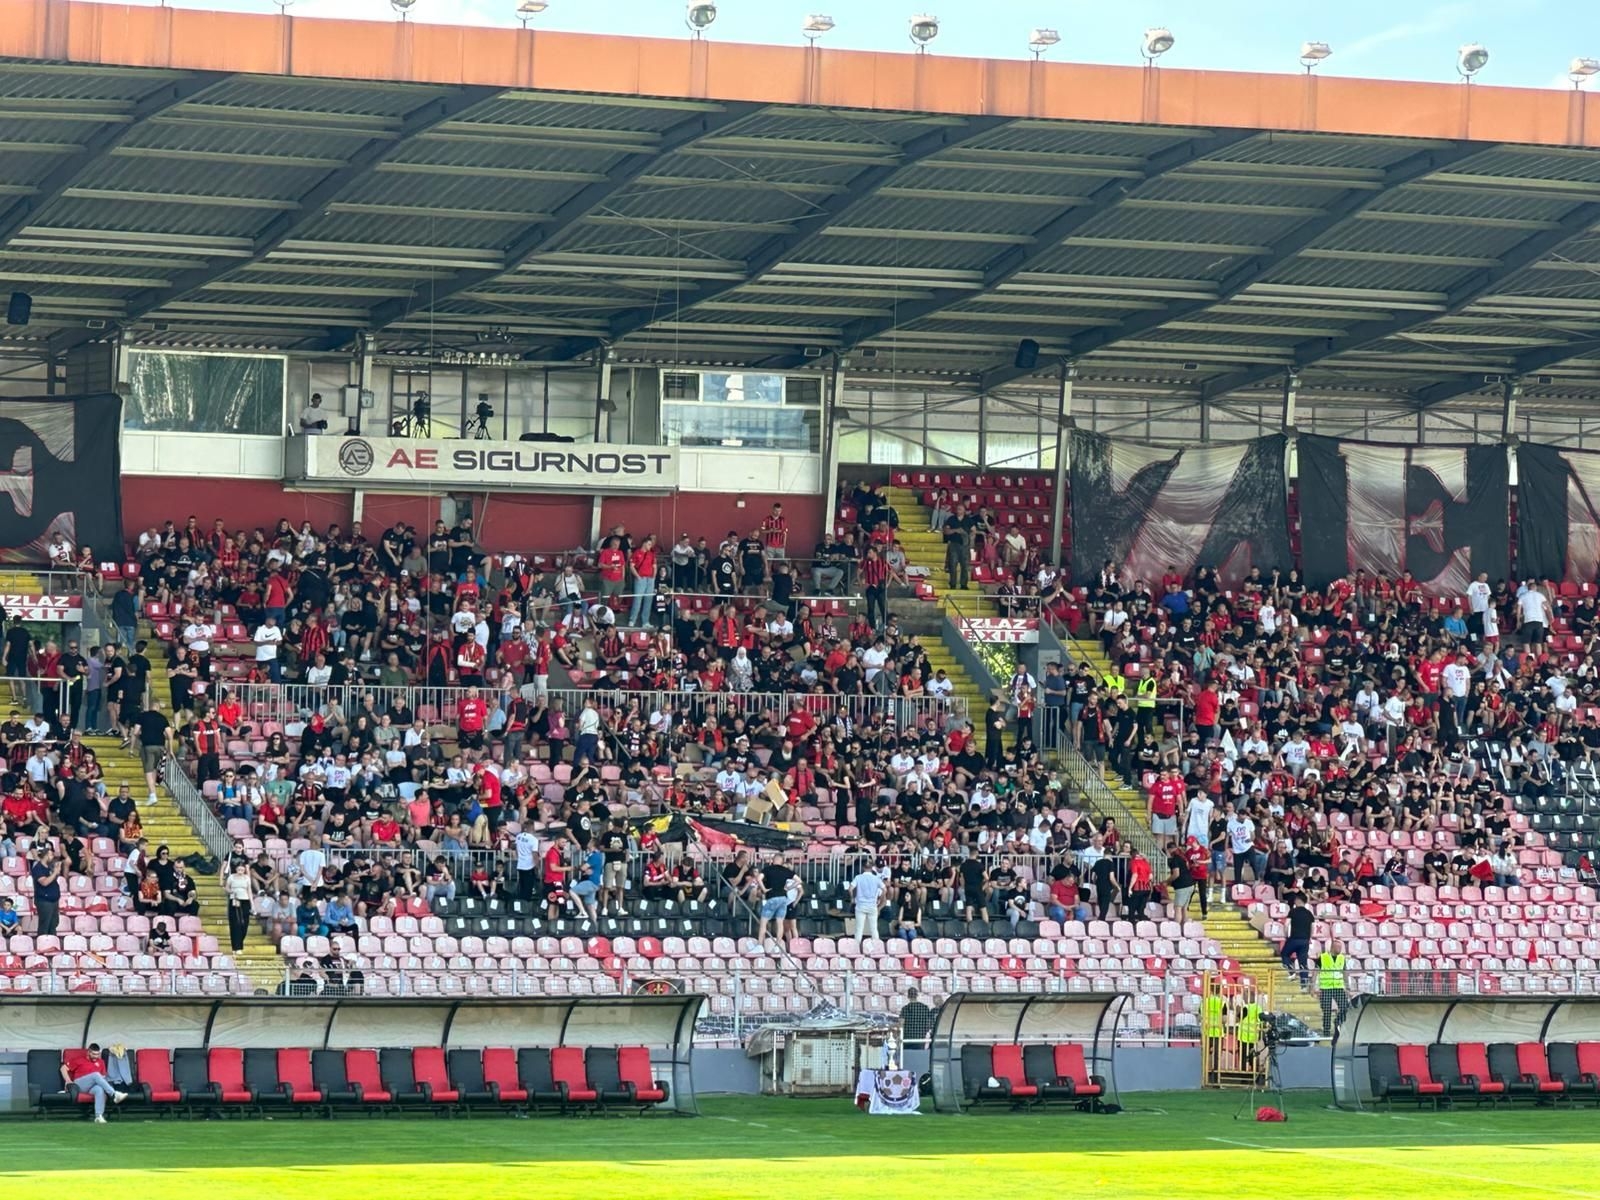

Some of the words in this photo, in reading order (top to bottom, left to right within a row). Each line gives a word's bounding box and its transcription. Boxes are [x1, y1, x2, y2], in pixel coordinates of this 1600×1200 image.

[386, 448, 438, 469] AE
[453, 450, 671, 474] SIGURNOST
[962, 618, 1026, 629] IZLAZ
[962, 631, 1024, 641] EXIT
